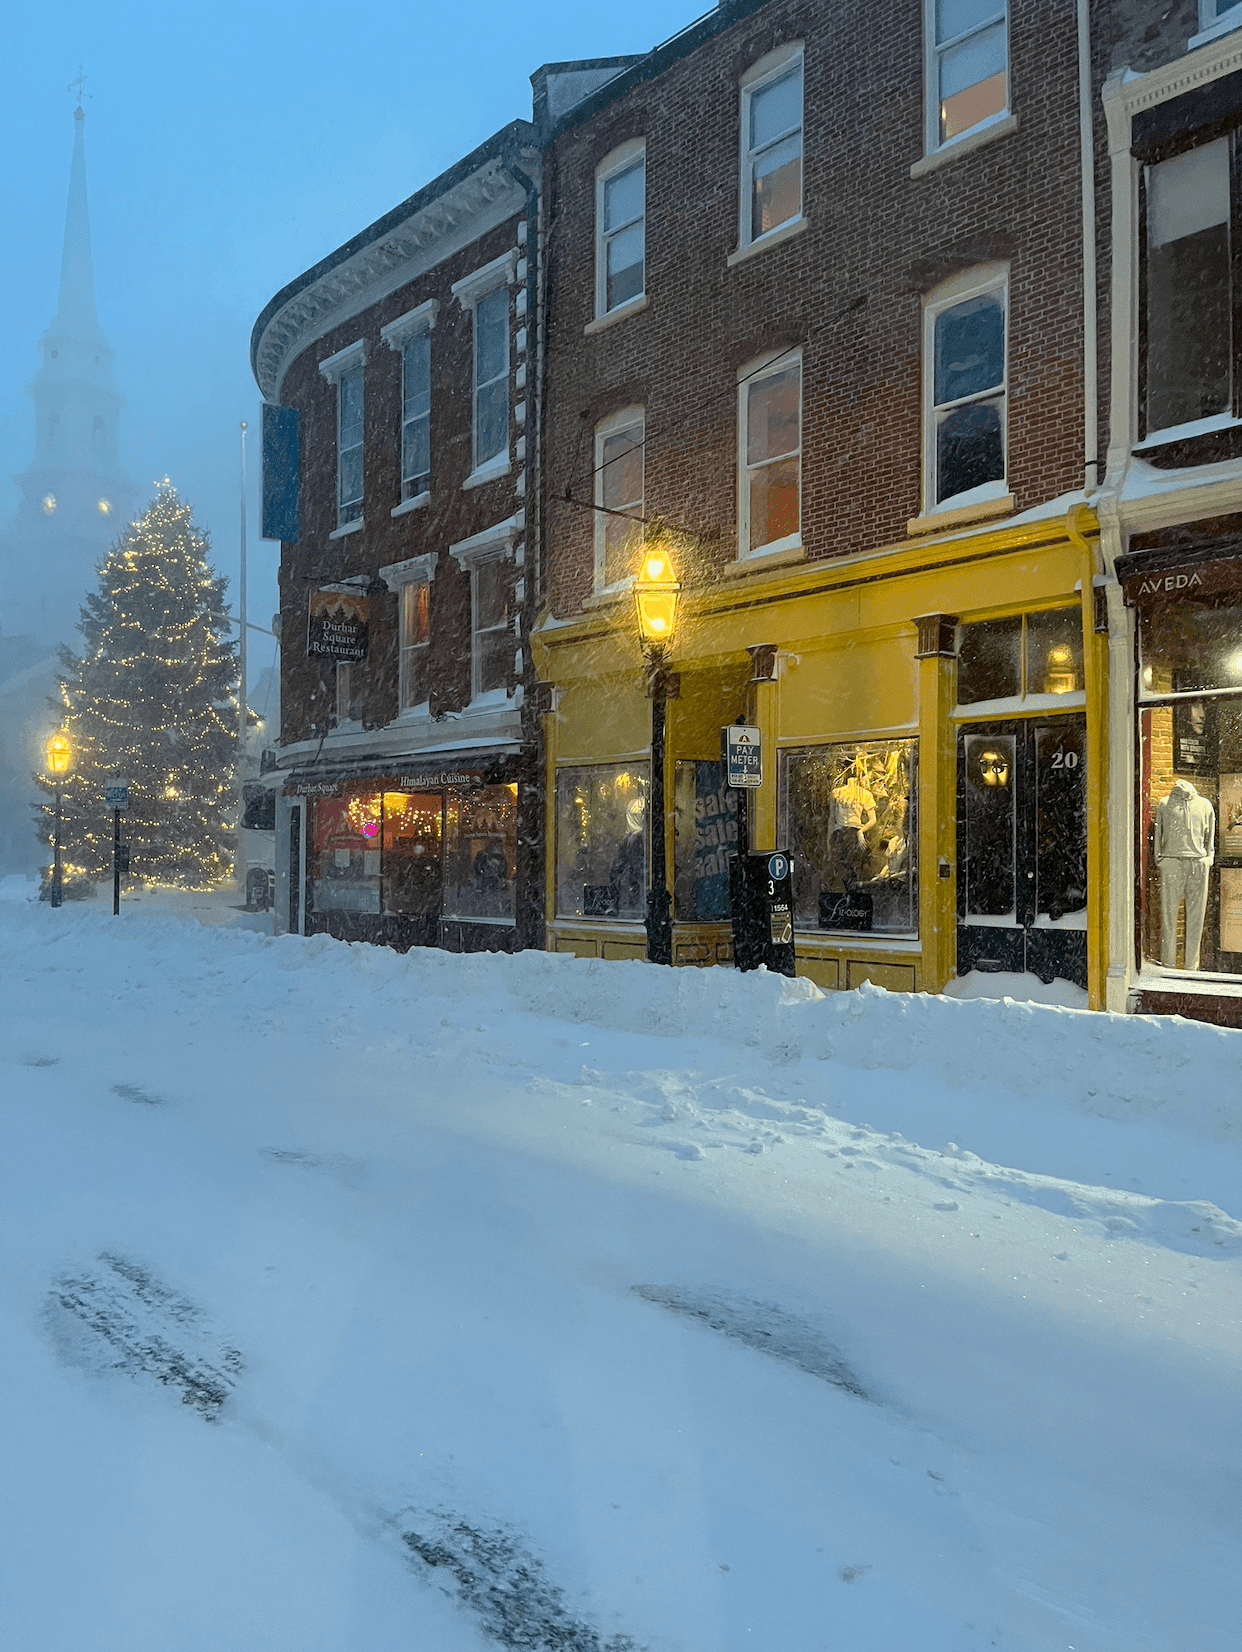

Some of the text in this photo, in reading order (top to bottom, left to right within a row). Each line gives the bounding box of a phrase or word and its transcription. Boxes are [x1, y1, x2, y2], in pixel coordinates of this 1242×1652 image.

[1138, 573, 1203, 596] AVEDA
[322, 621, 358, 633] Durbar
[322, 632, 356, 644] Square
[313, 641, 365, 656] Restaurant
[736, 746, 754, 755] PAY
[730, 755, 759, 765] METER
[1050, 751, 1078, 769] 20
[400, 773, 470, 787] Himalayan Cuisine
[317, 782, 338, 794] Square
[694, 788, 738, 819] sale
[694, 819, 738, 850] sale
[775, 858, 783, 876] P
[768, 880, 775, 895] 3
